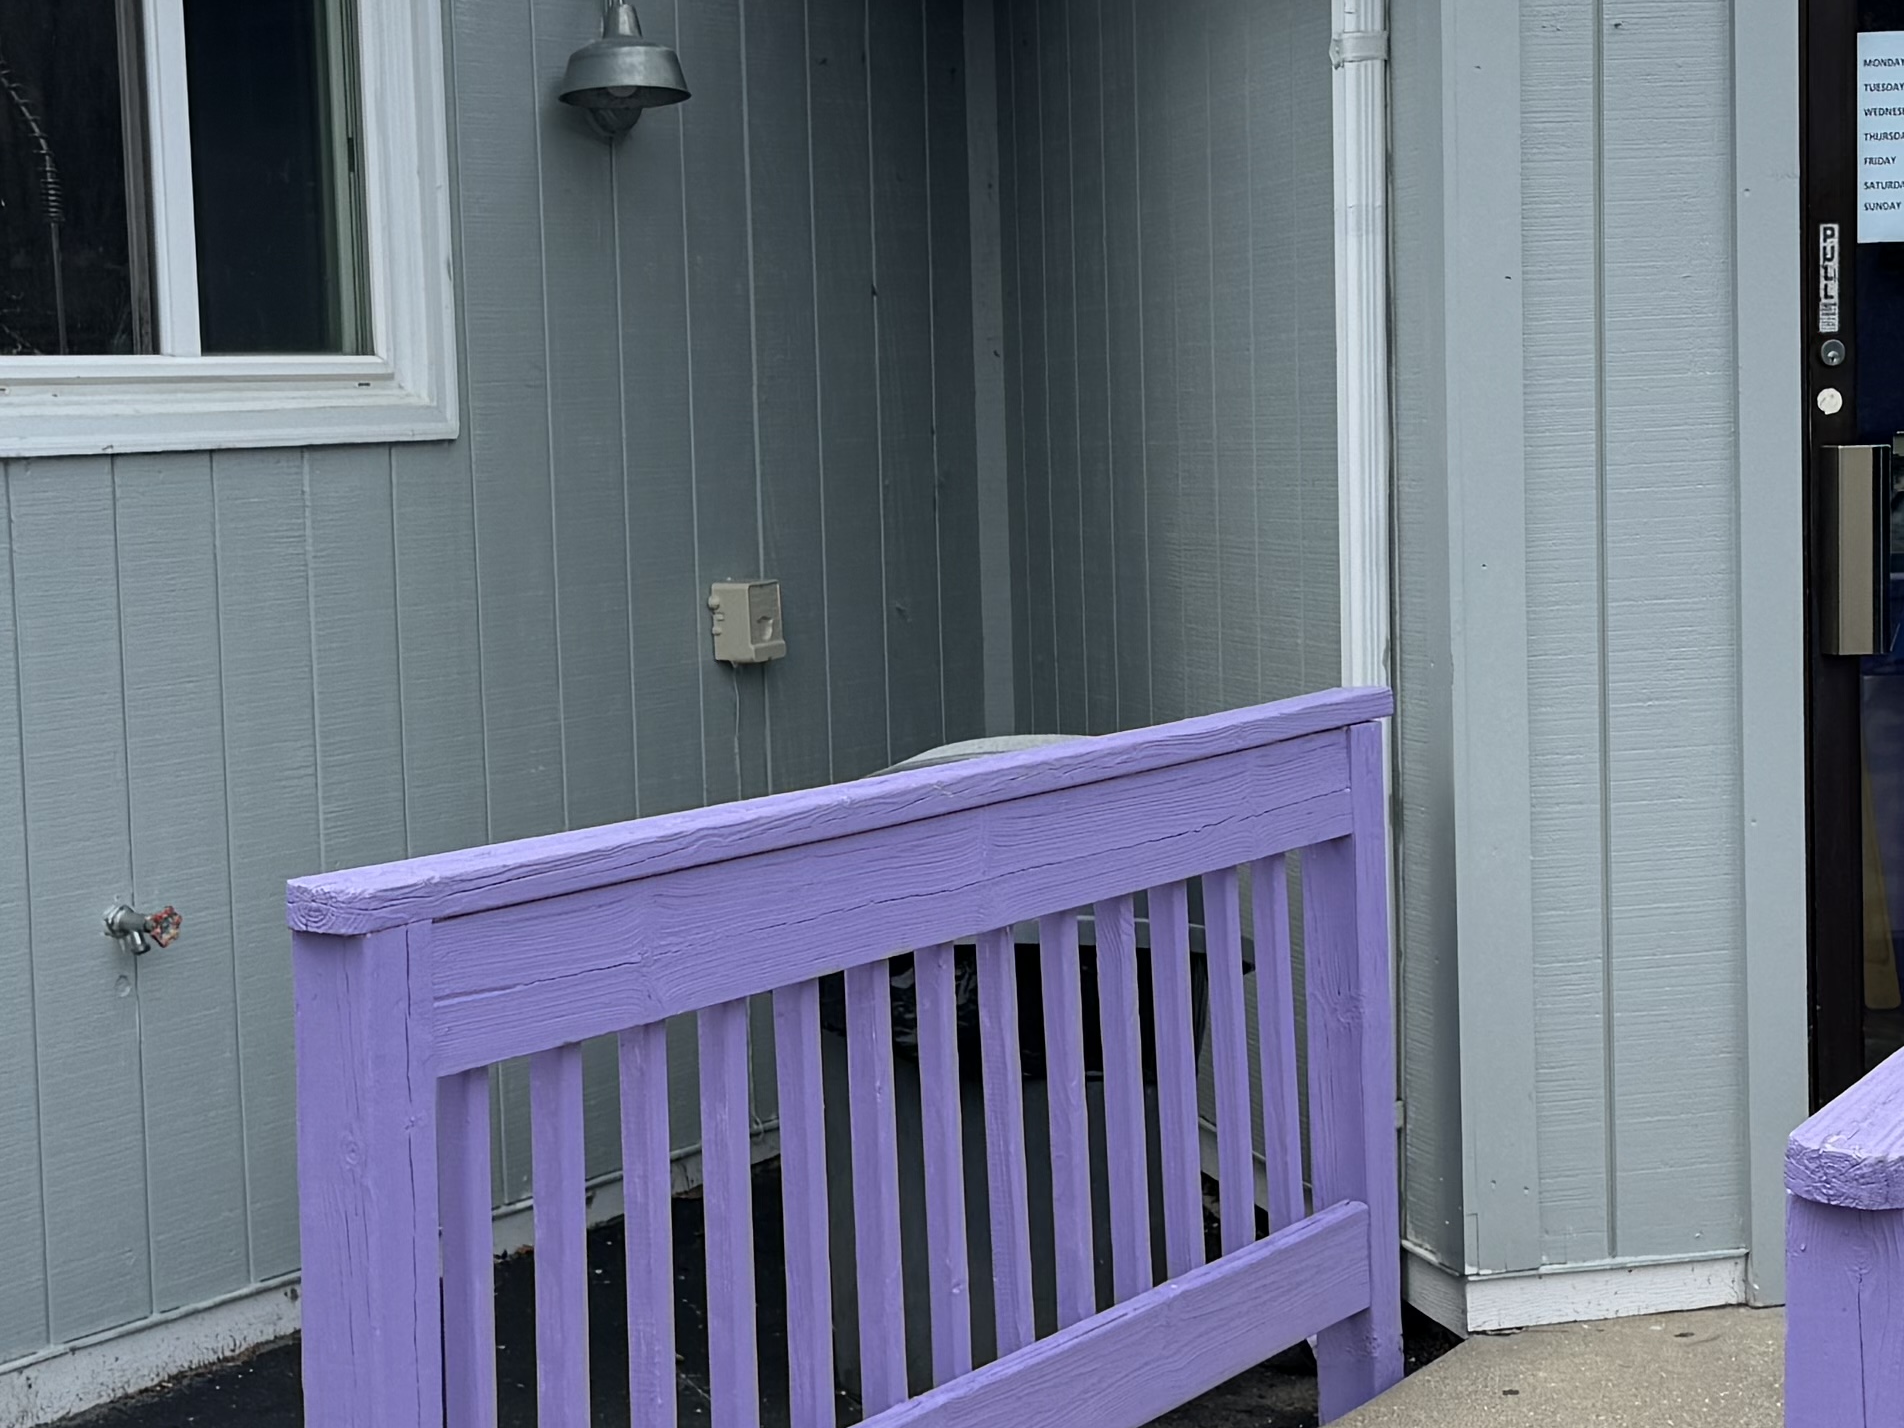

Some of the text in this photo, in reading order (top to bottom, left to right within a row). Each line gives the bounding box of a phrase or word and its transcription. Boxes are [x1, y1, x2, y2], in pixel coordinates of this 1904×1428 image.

[1863, 82, 1904, 92] TUESDAY
[1863, 156, 1896, 165] FRIDAY
[1863, 202, 1902, 211] SUNDAY
[1823, 226, 1835, 300] PULL
